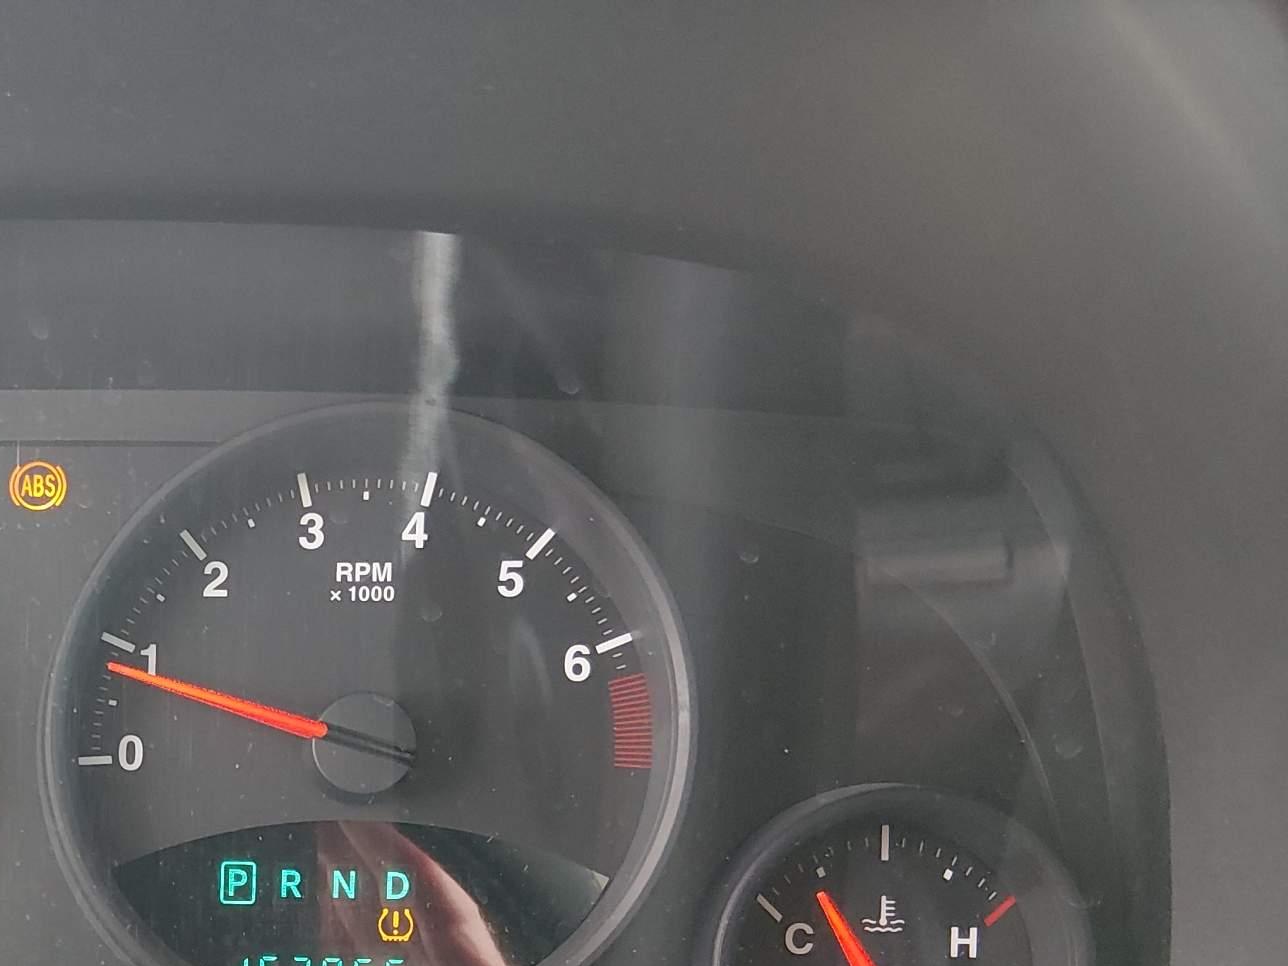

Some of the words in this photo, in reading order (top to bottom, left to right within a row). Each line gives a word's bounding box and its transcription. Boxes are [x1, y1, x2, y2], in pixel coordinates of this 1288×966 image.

[21, 474, 56, 497] ABS
[299, 513, 324, 549] 3
[401, 513, 428, 548] 4
[203, 562, 228, 597] 2
[335, 563, 392, 583] RPM
[498, 561, 523, 597] 5
[347, 586, 395, 602] 1000
[140, 644, 157, 676] 1
[563, 645, 590, 682] 6
[118, 735, 144, 771] 0
[228, 869, 248, 896] P
[280, 869, 302, 897] R
[332, 870, 356, 898] N
[386, 872, 410, 899] D
[785, 923, 814, 954] C
[950, 927, 977, 958] H
